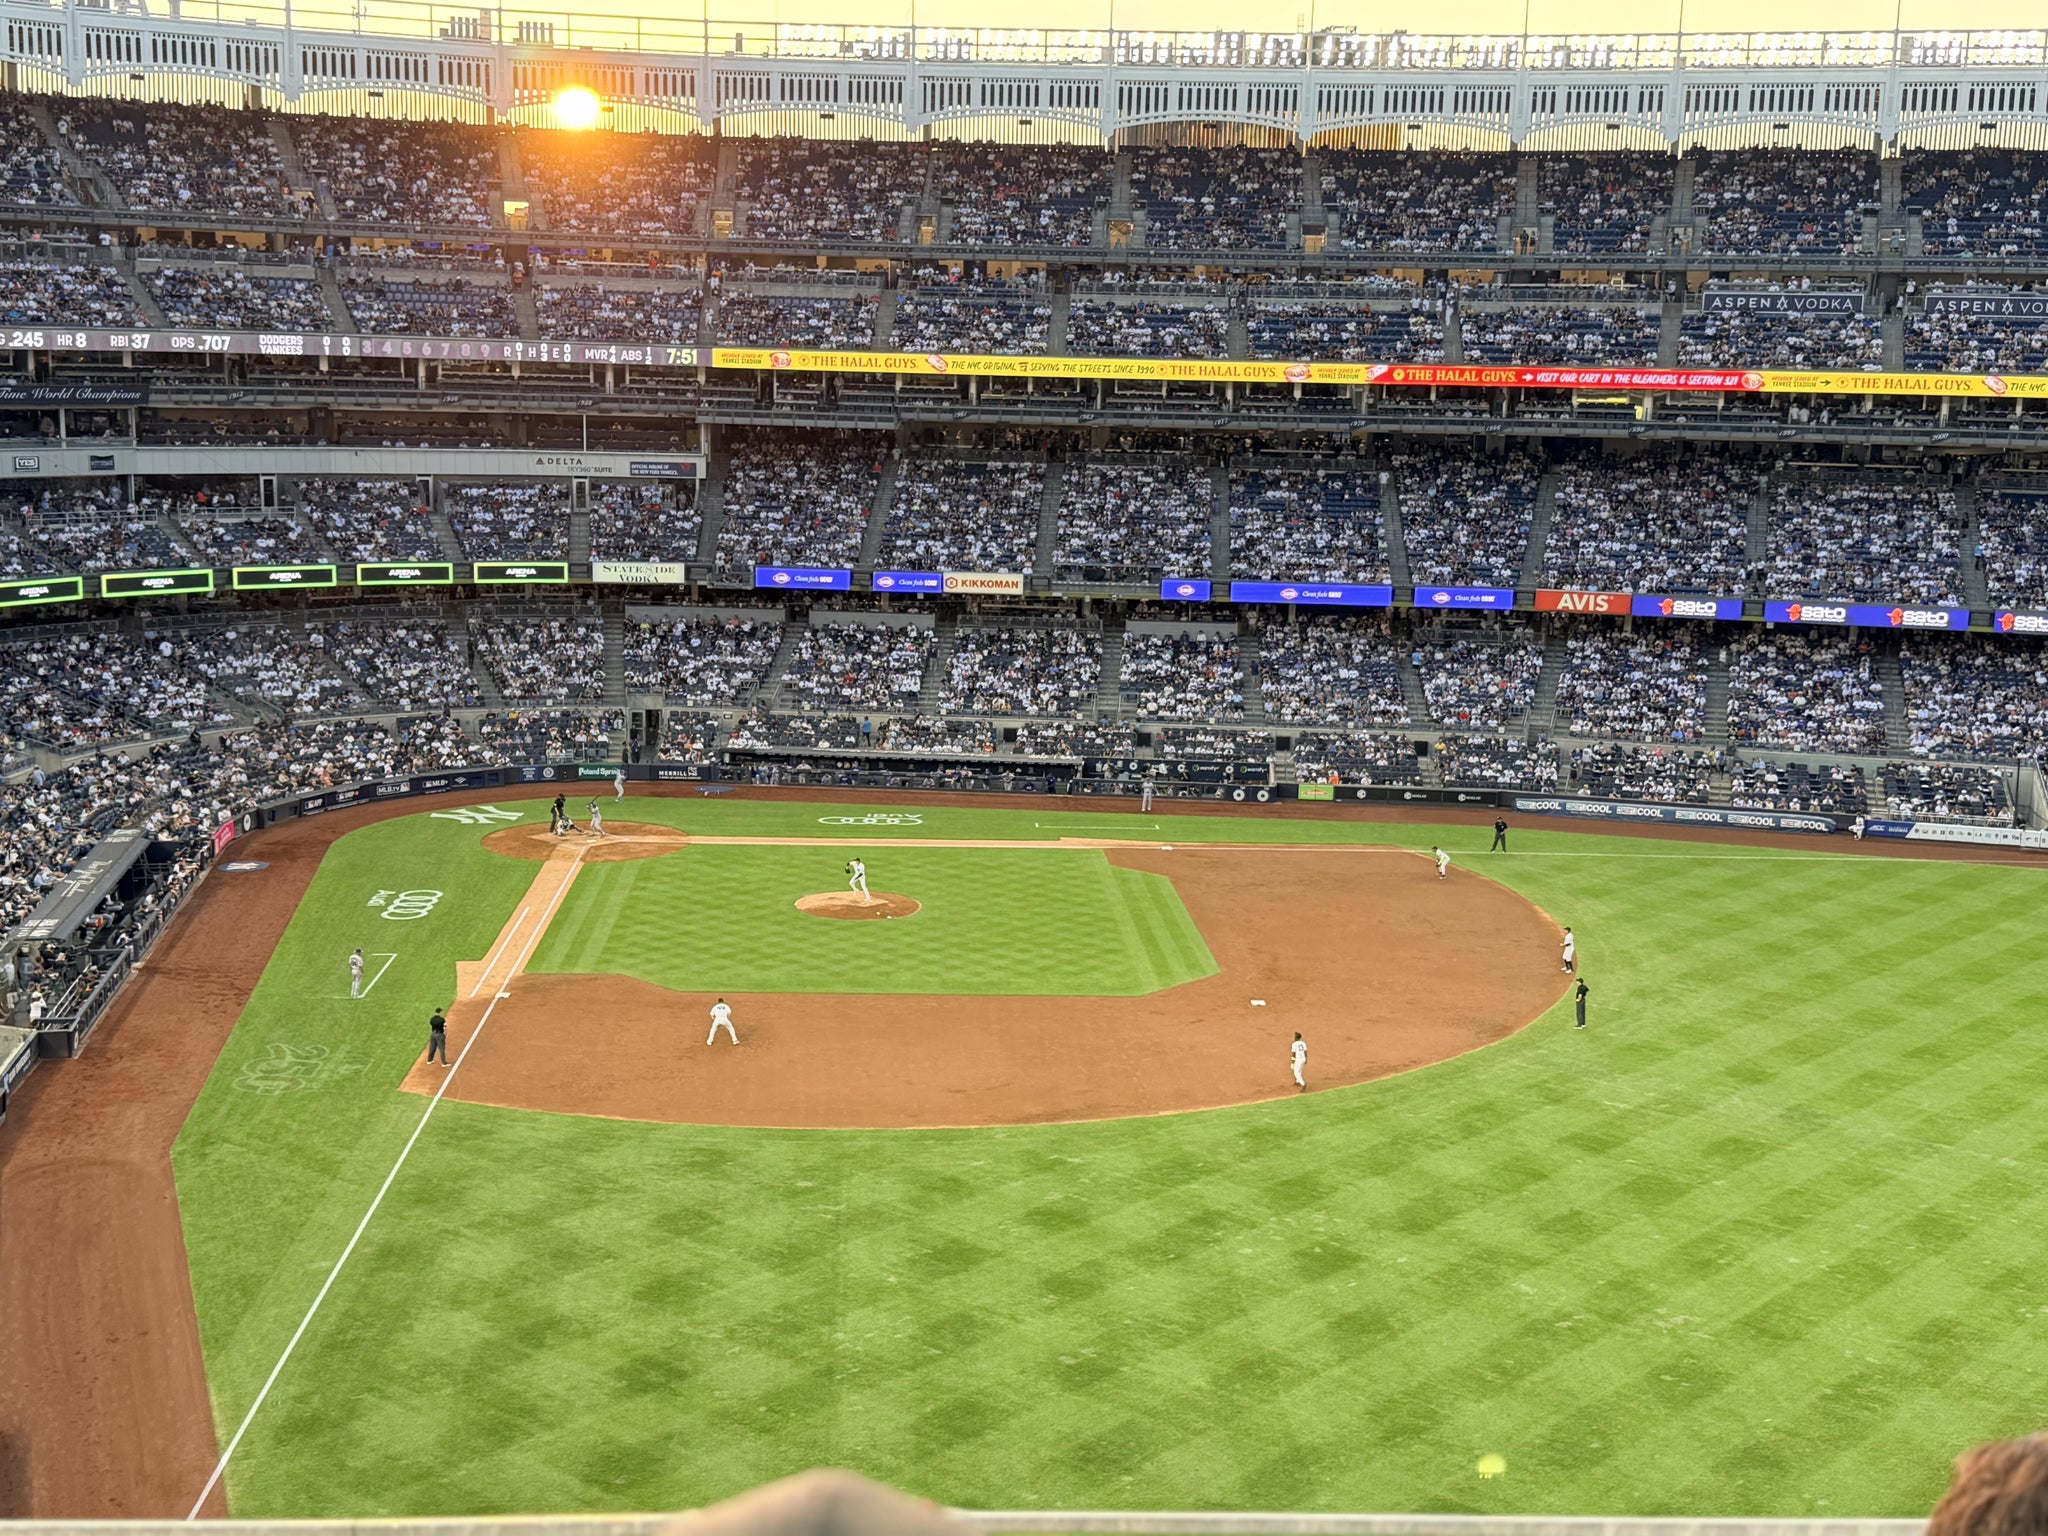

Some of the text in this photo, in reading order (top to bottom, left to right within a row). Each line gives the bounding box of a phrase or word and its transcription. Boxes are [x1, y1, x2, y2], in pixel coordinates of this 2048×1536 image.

[1712, 297, 1853, 310] ASPEN VODKA
[1934, 300, 1995, 312] ASPEN
[8, 332, 44, 348] .245
[57, 334, 72, 346] HR
[76, 332, 87, 348] 8
[110, 336, 128, 347] RBI
[131, 334, 150, 349] 37
[172, 337, 194, 348] OPS
[198, 336, 230, 350] .707
[259, 334, 350, 346] DODGERS 0 0
[260, 345, 350, 356] YANKEES 1 0
[362, 340, 490, 357] 3 4 5 6 7 8 9
[504, 346, 511, 357] R
[515, 342, 522, 351] 0
[540, 343, 547, 352] 0
[564, 344, 571, 353] 0
[609, 346, 616, 354] 4
[516, 352, 522, 360] 1
[528, 347, 536, 358] H
[540, 352, 548, 361] 3
[553, 347, 559, 358] E
[564, 353, 571, 362] 0
[585, 349, 608, 360] MVR
[621, 349, 642, 360] ABS
[667, 349, 697, 364] 7:51
[609, 354, 616, 363] 4
[645, 355, 652, 364] 2
[811, 356, 837, 367] THE
[841, 356, 881, 368] HALAL
[951, 361, 1155, 374] THE NYC ORIGINAL SERVING THE STREETS SINCE 1990
[1170, 365, 1195, 375] THE
[1199, 366, 1240, 376] HALAL
[1406, 370, 1433, 380] THE
[1436, 371, 1478, 381] HALAL
[1536, 372, 1559, 382] VISIT
[1560, 373, 1577, 382] OUR
[1578, 373, 1599, 383] CART
[1601, 374, 1611, 383] IN
[1614, 374, 1630, 384] THE
[1632, 374, 1678, 385] BLEACHERS
[1687, 375, 1722, 386] SECTION
[1724, 376, 1738, 386] 321
[1851, 378, 1880, 389] THE
[1884, 378, 1930, 390] HALAL
[2010, 383, 2046, 392] THE NYC
[0, 388, 141, 402] Time World Champions
[602, 564, 676, 574] STATESIDE
[619, 575, 659, 583] VODKA
[961, 579, 1019, 589] KIKKOMAN
[1557, 594, 1609, 611] AVIS
[1673, 600, 1717, 613] sato
[1801, 606, 1846, 619] sato
[1902, 610, 1949, 623] sato
[2014, 616, 2048, 628] sat
[579, 767, 600, 776] Poland
